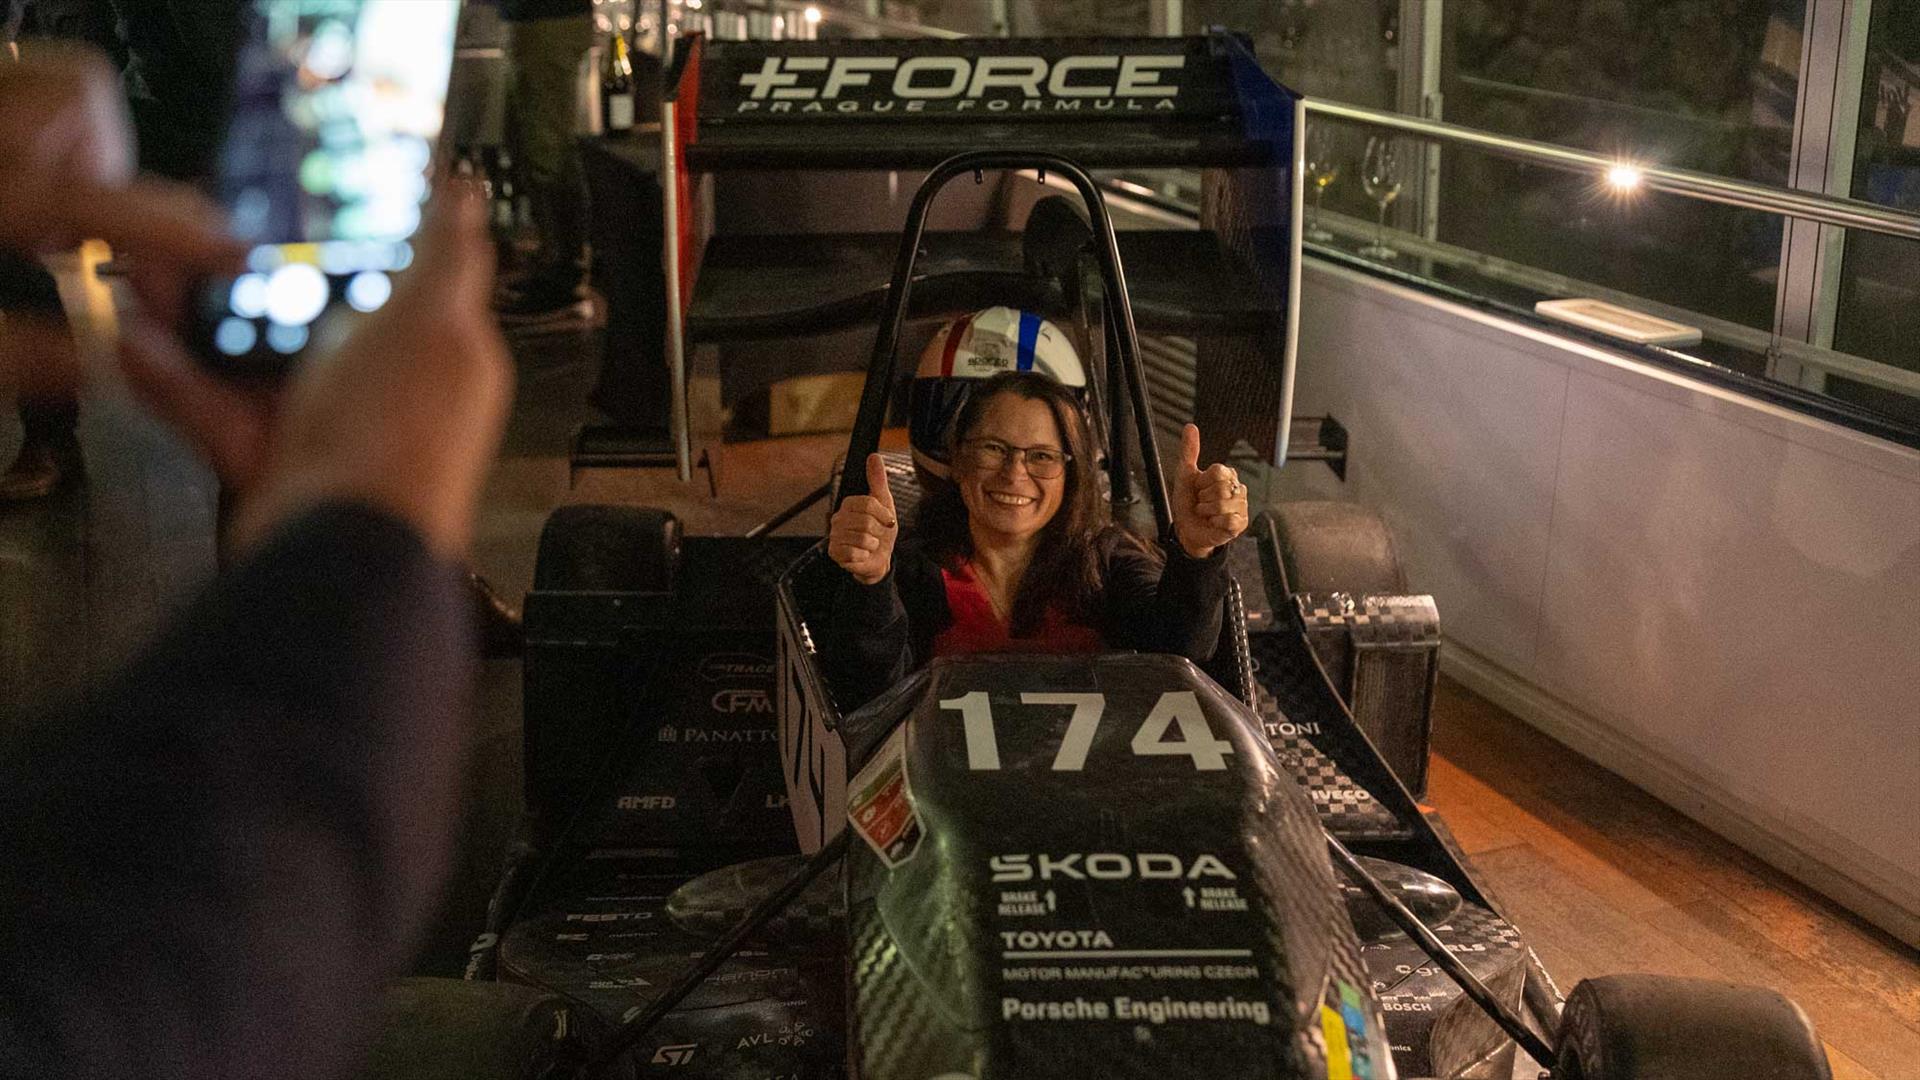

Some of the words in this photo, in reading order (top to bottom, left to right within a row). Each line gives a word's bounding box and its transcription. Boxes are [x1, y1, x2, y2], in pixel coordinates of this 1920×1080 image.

[737, 99, 926, 114] PRAGUE
[956, 98, 1178, 112] FORMULA
[684, 727, 780, 743] PANATTO
[939, 690, 1235, 771] 174
[1264, 721, 1321, 736] TONI
[1311, 789, 1371, 801] IVECO
[1000, 890, 1037, 903] BRAKE
[1200, 886, 1237, 899] BRAKE
[998, 902, 1047, 915] RELEASE
[1200, 897, 1248, 911] RELEASE
[1000, 929, 1114, 950] TOYOTA
[1002, 966, 1063, 981] MOTOR
[1064, 964, 1202, 980] MANUFACTURING
[1203, 963, 1260, 979] CZECH
[1001, 996, 1110, 1021] Porsche
[1113, 994, 1271, 1025] Engineering
[1382, 1002, 1433, 1012] BOSCH
[736, 1032, 774, 1050] AVL
